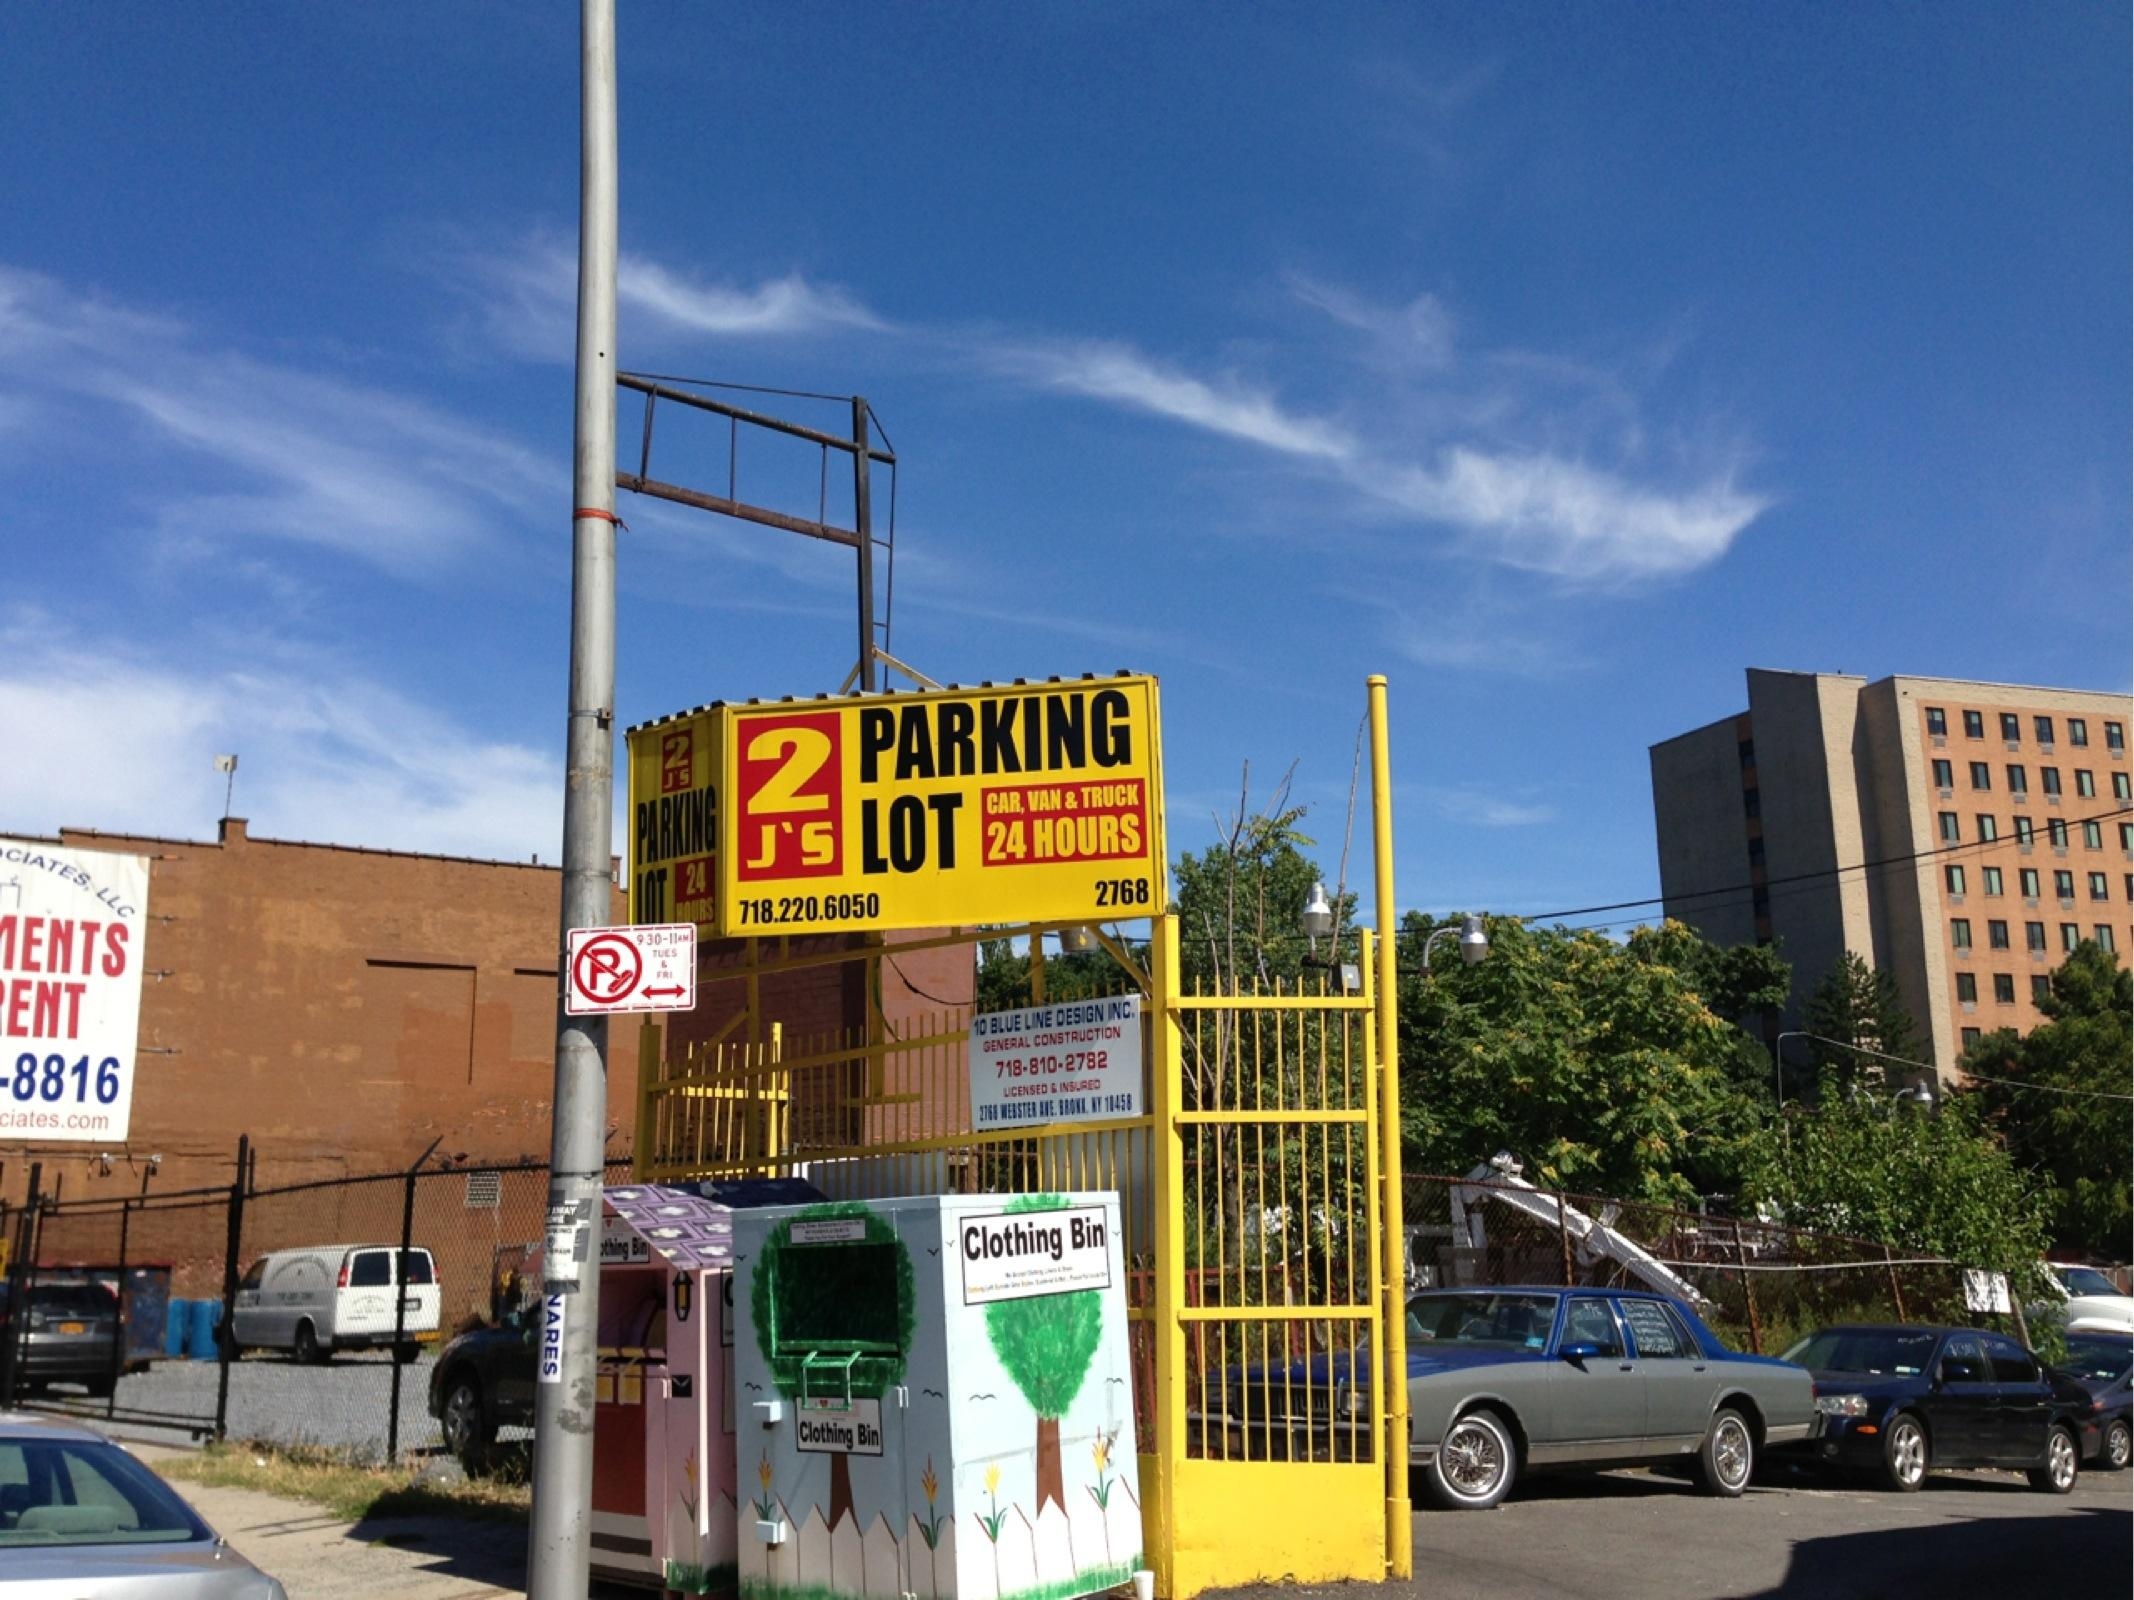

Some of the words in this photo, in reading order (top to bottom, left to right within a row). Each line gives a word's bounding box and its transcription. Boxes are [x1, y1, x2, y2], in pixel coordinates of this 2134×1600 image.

[665, 736, 689, 769] 2
[860, 690, 1132, 783] PARKING
[748, 727, 832, 815] 2
[986, 790, 1024, 814] CAR,
[1027, 788, 1061, 811] VAN
[1065, 791, 1078, 809] &
[1081, 785, 1139, 809] TRUCK
[637, 784, 716, 865] PARKING
[862, 792, 963, 875] LOT
[987, 820, 1025, 861] 24
[1034, 813, 1141, 858] HOURS
[0, 848, 90, 891] CIATES,
[97, 887, 135, 917] LLC
[686, 862, 705, 895] 24
[1095, 878, 1149, 907] 2768
[637, 868, 667, 924] LOT
[676, 897, 714, 923] HOURS
[740, 893, 879, 924] 718.220.6050
[652, 949, 677, 958] TUES
[661, 960, 667, 968] &
[656, 971, 672, 980] FRI
[0, 978, 87, 1040] ENT
[991, 1015, 1020, 1034] BLUE
[1025, 1010, 1052, 1030] LINE
[1057, 1005, 1103, 1026] DESIGN
[1108, 1001, 1135, 1020] INC.
[983, 1037, 1030, 1052] GENERAL
[1034, 1026, 1120, 1047] CONSTRUCTION
[1004, 1083, 1047, 1097] LICENSED
[1051, 1082, 1057, 1093] &
[1060, 1080, 1100, 1092] INSURED
[1001, 1101, 1037, 1119] WEBSTER
[1092, 1097, 1102, 1112] NY
[965, 1222, 1062, 1261] Clothing
[1070, 1217, 1104, 1250] Bin
[800, 1421, 853, 1450] Clothing
[857, 1423, 879, 1446] Bin
